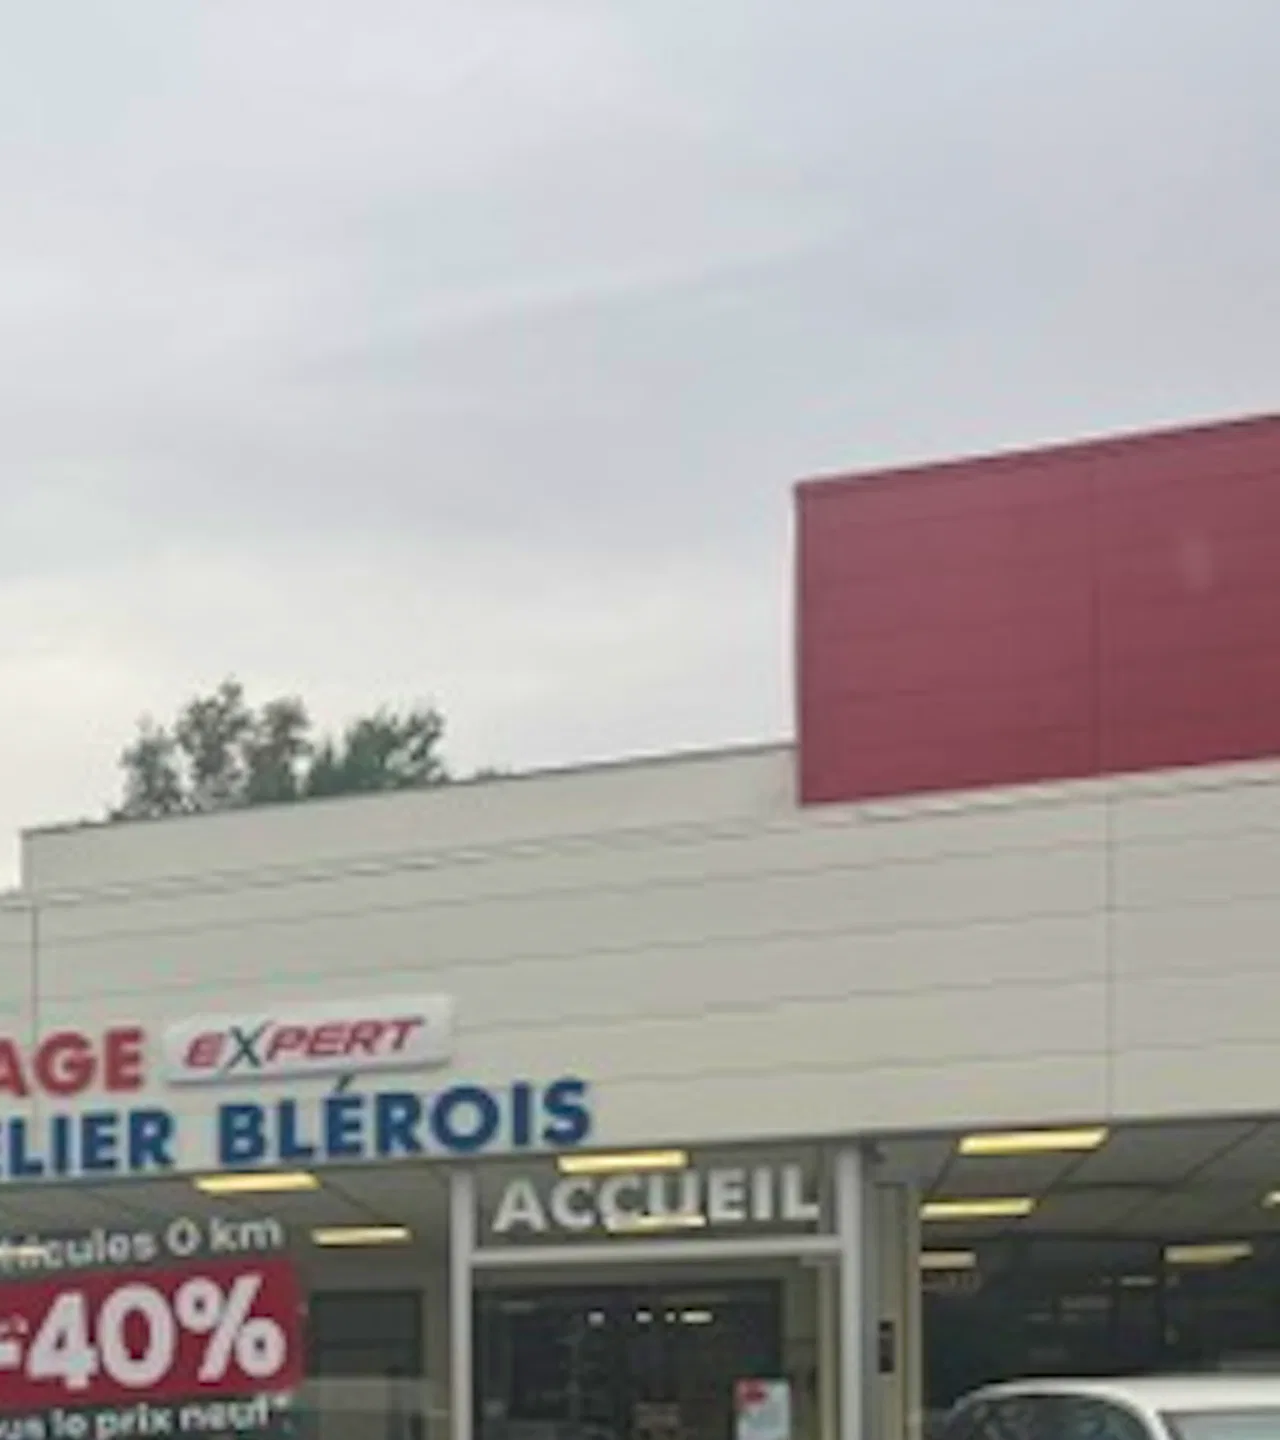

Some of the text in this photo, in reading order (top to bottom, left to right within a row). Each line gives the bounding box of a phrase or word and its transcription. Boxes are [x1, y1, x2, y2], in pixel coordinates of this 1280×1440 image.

[219, 1075, 592, 1165] BLÉROIS
[492, 1165, 822, 1234] ACCUEIL
[210, 1217, 282, 1250] km
[51, 1409, 88, 1438] le
